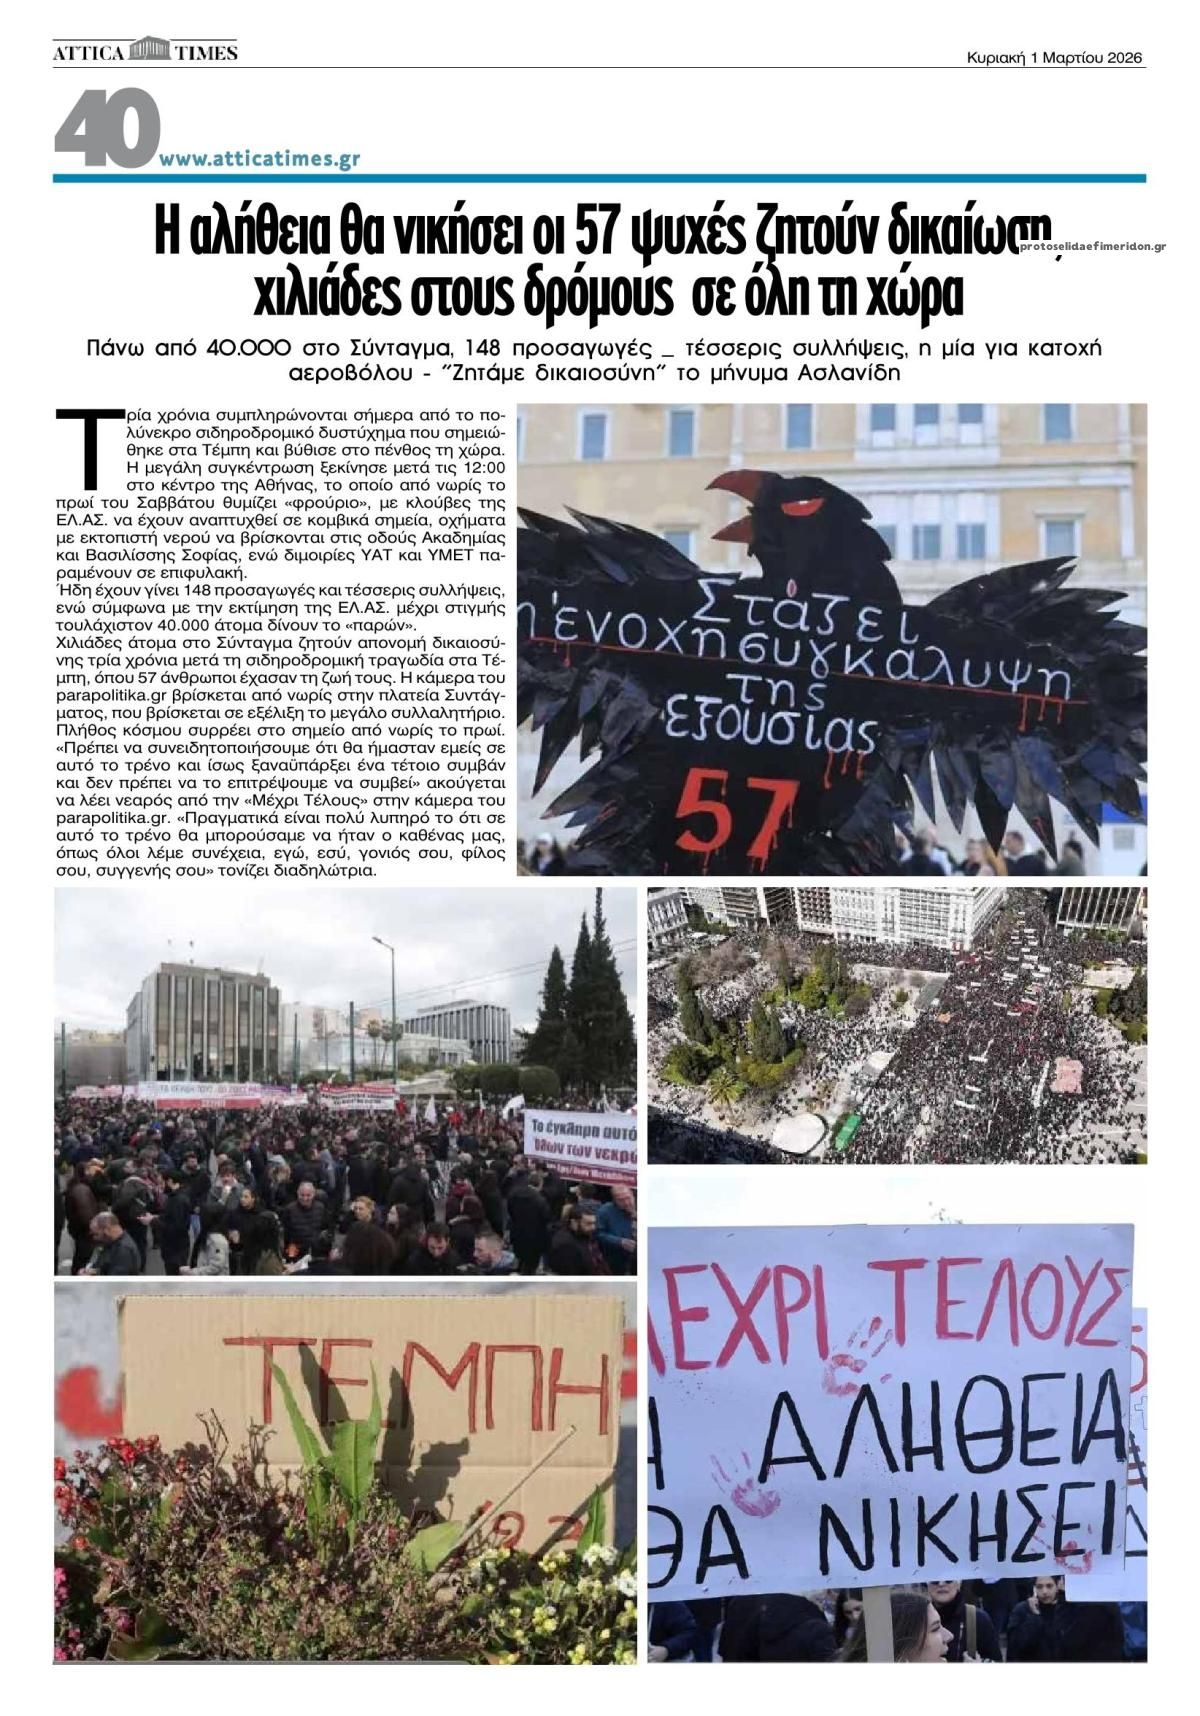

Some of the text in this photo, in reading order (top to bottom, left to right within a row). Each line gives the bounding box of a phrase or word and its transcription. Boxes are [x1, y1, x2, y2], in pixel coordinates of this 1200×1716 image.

[54, 46, 237, 60] ATTICA TIMES
[967, 50, 1143, 67] Κυριακή 1 Μαρτίου 2026
[54, 87, 161, 169] 40
[159, 149, 361, 172] www.atticatimes.gr
[155, 202, 180, 255] Η
[189, 199, 332, 256] αλήθεια
[340, 201, 385, 256] θα
[392, 199, 524, 255] νικήσει
[532, 214, 565, 256] οι
[575, 202, 621, 256] 57
[632, 199, 747, 267] ψυχές
[754, 199, 881, 263] ζητούν
[253, 261, 964, 330] χιλιάδες στους δρόμους σε όλη τη χώρα
[87, 337, 145, 357] Πάνω
[155, 337, 197, 357] από
[206, 338, 292, 357] 40.000
[302, 342, 340, 357] στο
[350, 337, 454, 360] Σύνταγμα,
[466, 338, 501, 357] 148
[513, 337, 653, 360] προσαγωγές
[685, 337, 782, 360] τέσσερις
[792, 337, 909, 360] συλλήψεις,
[919, 342, 932, 357] η
[942, 337, 975, 360] μία
[985, 342, 1018, 360] για
[1028, 337, 1102, 357] κατοχή
[288, 362, 413, 385] αεροβόλου
[676, 367, 700, 381] το
[710, 362, 788, 385] μήνυμα
[797, 362, 901, 382] Ασλανίδη
[157, 407, 211, 425] χρόνια
[215, 407, 348, 425] συμπληρώνονται
[353, 407, 414, 425] σήμερα
[419, 407, 451, 422] από
[455, 411, 474, 422] το
[479, 411, 506, 422] πο-
[126, 425, 506, 442] λύνεκρο σιδηροδρομικό δυστύχημα που σημειώ-
[127, 460, 506, 477] Η μεγάλη συγκέντρωση ξεκίνησε μετά τις 12:00
[126, 477, 506, 495] στο κέντρο της Αθήνας, το οποίο από νωρίς το
[55, 495, 506, 512] πρωί του Σαββάτου θυμίζει «φρούριο», με κλούβες της
[56, 547, 506, 565] και Βασιλίσσης Σοφίας, ενώ διμοιρίες ΥΑΤ και ΥΜΕΤ πα-
[56, 565, 248, 582] ραμένουν σε επιφυλακή.
[55, 618, 417, 635] τουλάχιστον 40.000 άτομα δίνουν το «παρών».
[56, 687, 506, 705] parapolitika.gr βρίσκεται από νωρίς στην πλατεία Συντάγ-
[725, 673, 828, 711] της
[56, 722, 505, 740] Πλήθος κόσμου συρρέει στο σημείο από νωρίς το πρωί.
[56, 810, 506, 827] parapolitika.gr. «Πραγματικά είναι πολύ λυπηρό το ότι σε
[676, 767, 801, 868] 57
[56, 863, 377, 880] σου, συγγενής σου» τονίζει διαδηλώτρια.
[531, 1118, 544, 1133] Το
[867, 1255, 1131, 1347] ΤΕΛΟΥΣ
[223, 1335, 610, 1436] ΤΕΜΠΗ
[757, 1368, 1126, 1484] ΑΛΗΘΕΙΑ
[819, 1479, 1116, 1576] ΝΙΚΗΣΕΙ
